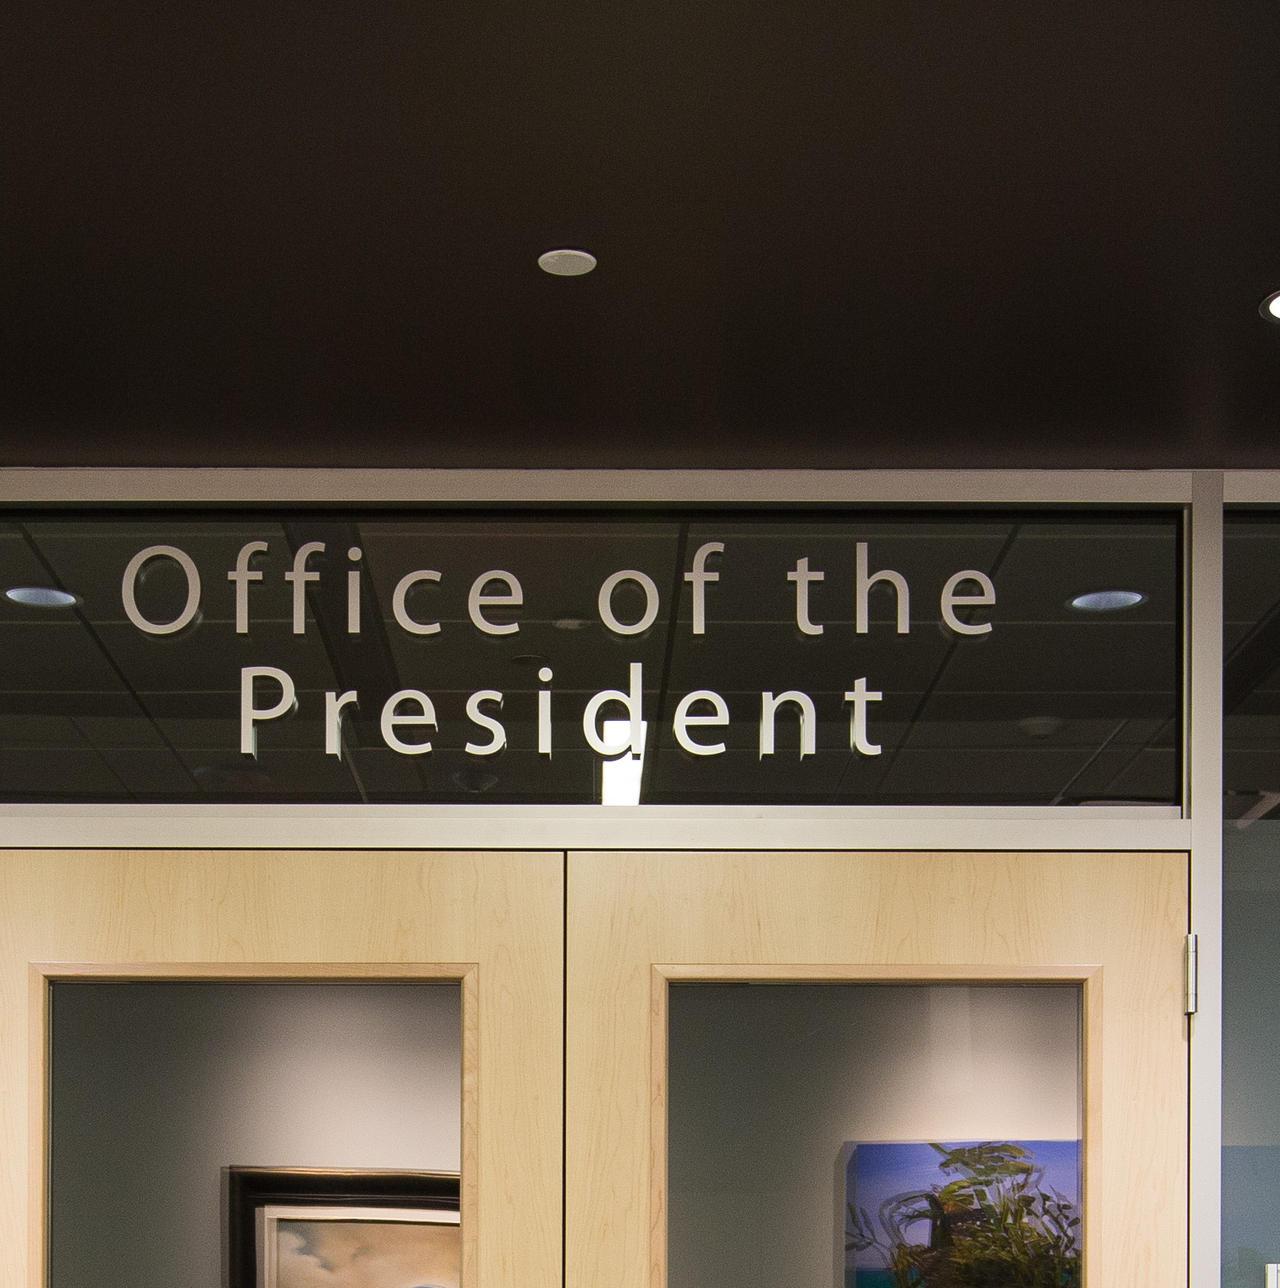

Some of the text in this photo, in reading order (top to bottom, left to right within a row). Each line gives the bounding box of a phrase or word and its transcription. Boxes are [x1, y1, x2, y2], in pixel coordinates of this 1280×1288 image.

[120, 541, 999, 636] Office of the
[239, 662, 884, 757] President
